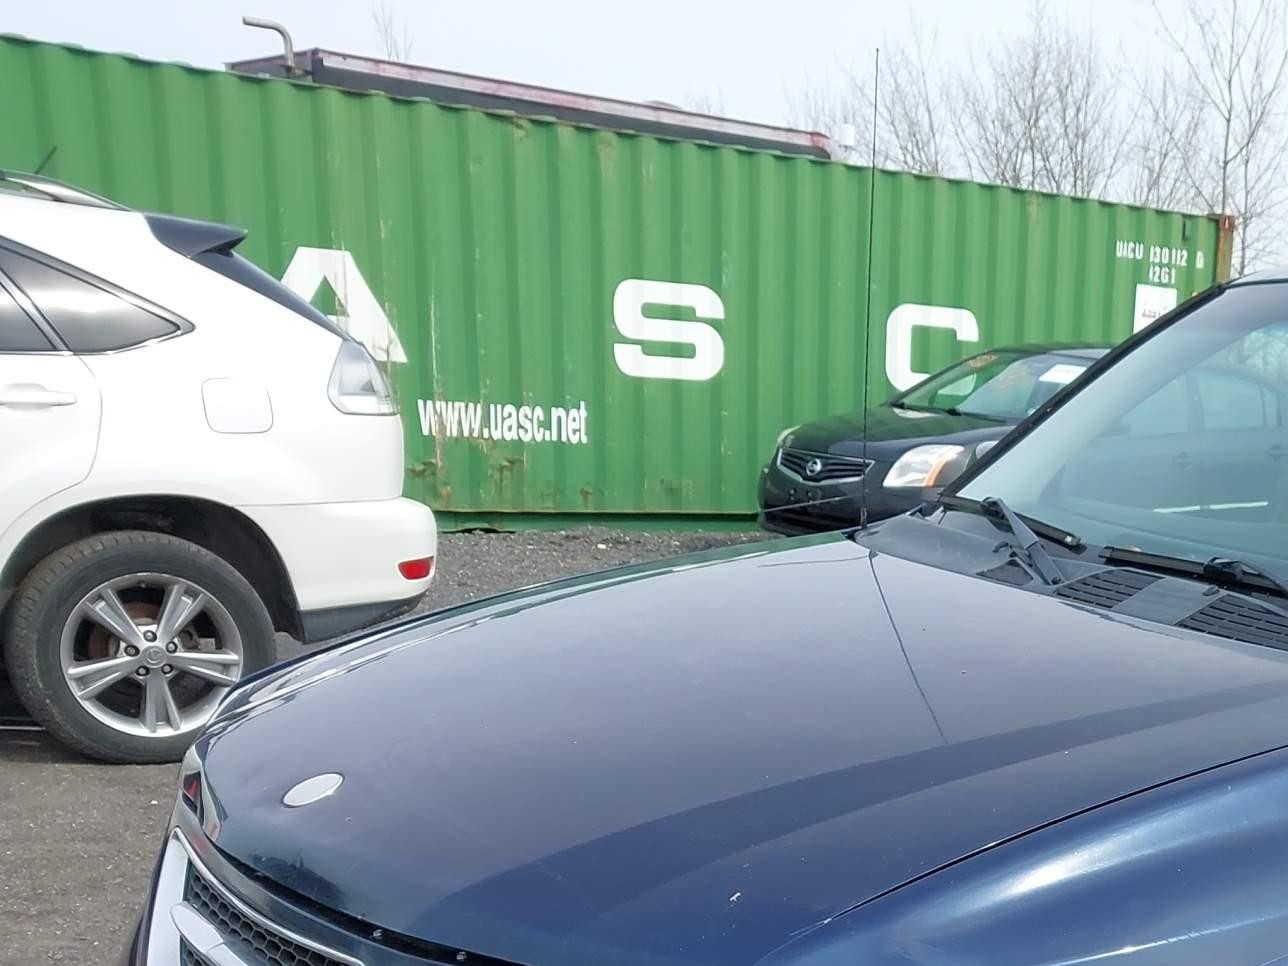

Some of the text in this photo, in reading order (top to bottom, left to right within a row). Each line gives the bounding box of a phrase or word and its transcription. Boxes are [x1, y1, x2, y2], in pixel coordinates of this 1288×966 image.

[280, 246, 979, 396] A S C
[417, 398, 588, 444] www.uasc.net
